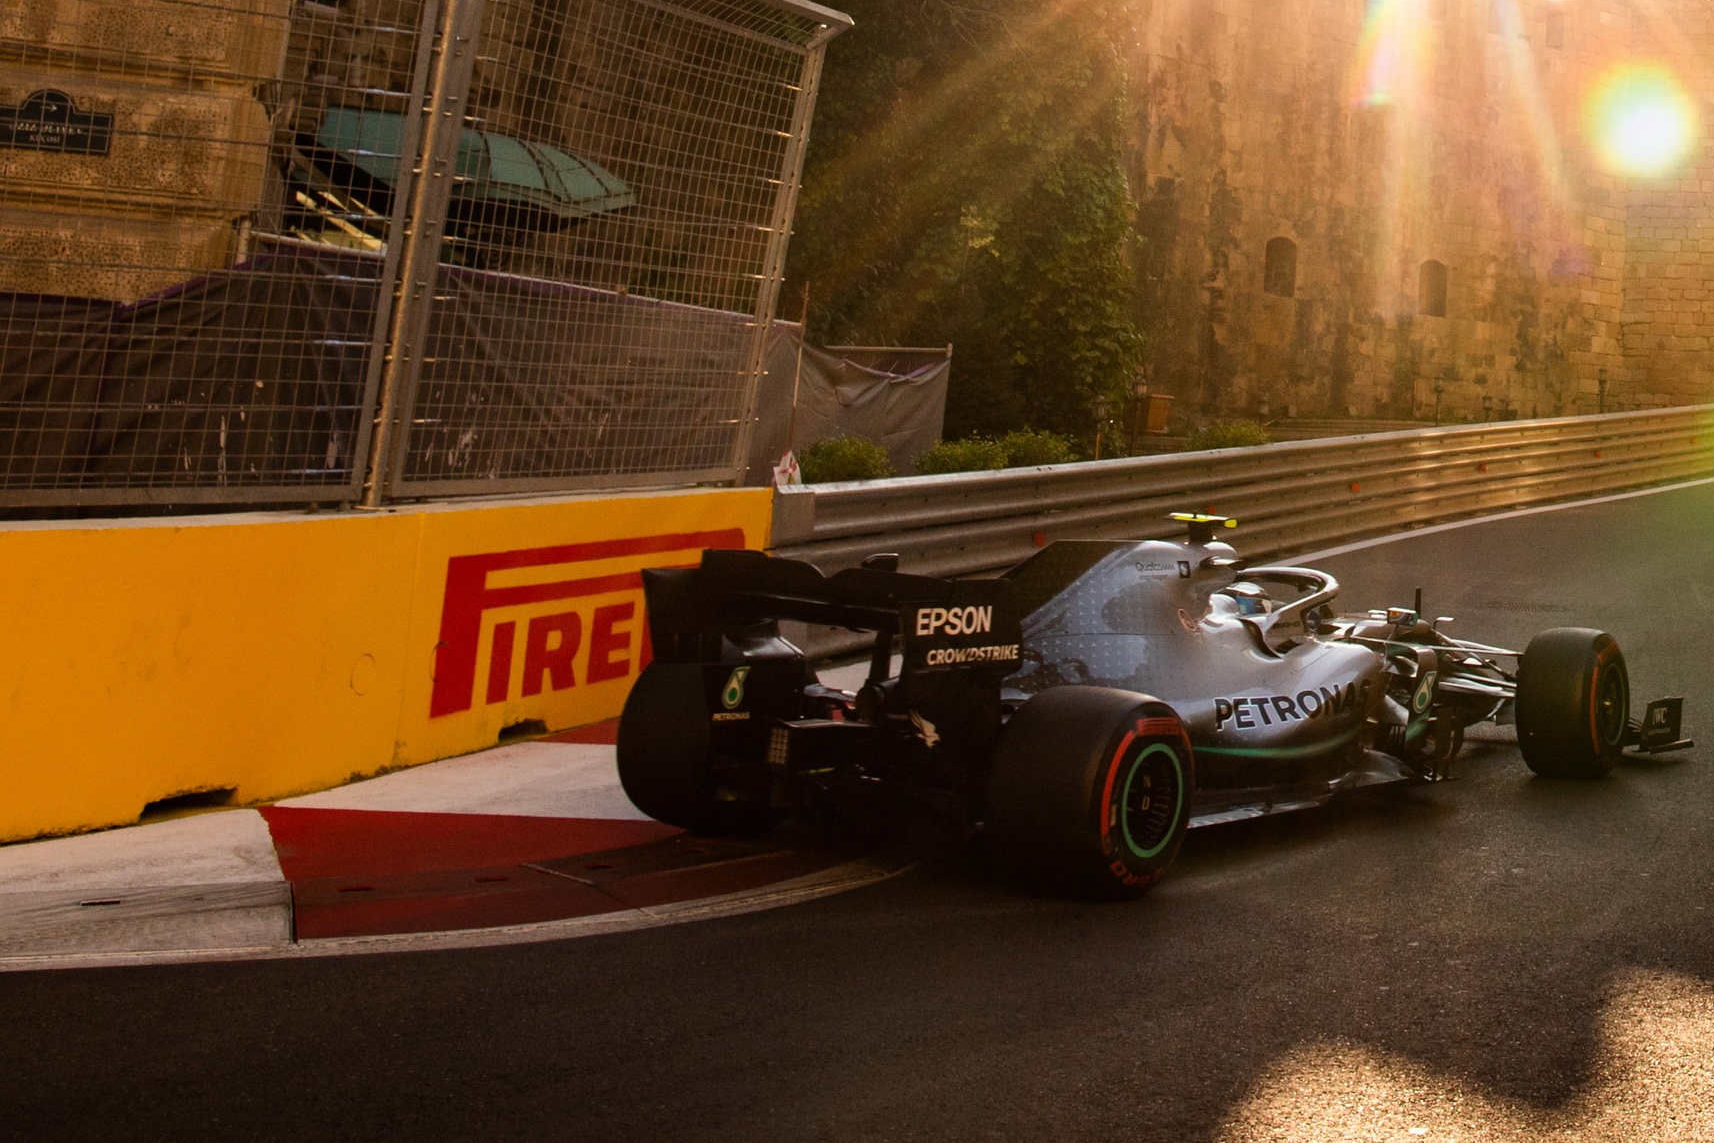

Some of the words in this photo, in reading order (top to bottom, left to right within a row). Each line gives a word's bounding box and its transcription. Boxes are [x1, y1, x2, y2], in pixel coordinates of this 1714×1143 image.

[429, 527, 746, 721] PIRE
[916, 605, 993, 636] EPSON
[926, 644, 1019, 666] CROWDSTRIKE
[1214, 678, 1372, 731] PETRONAS
